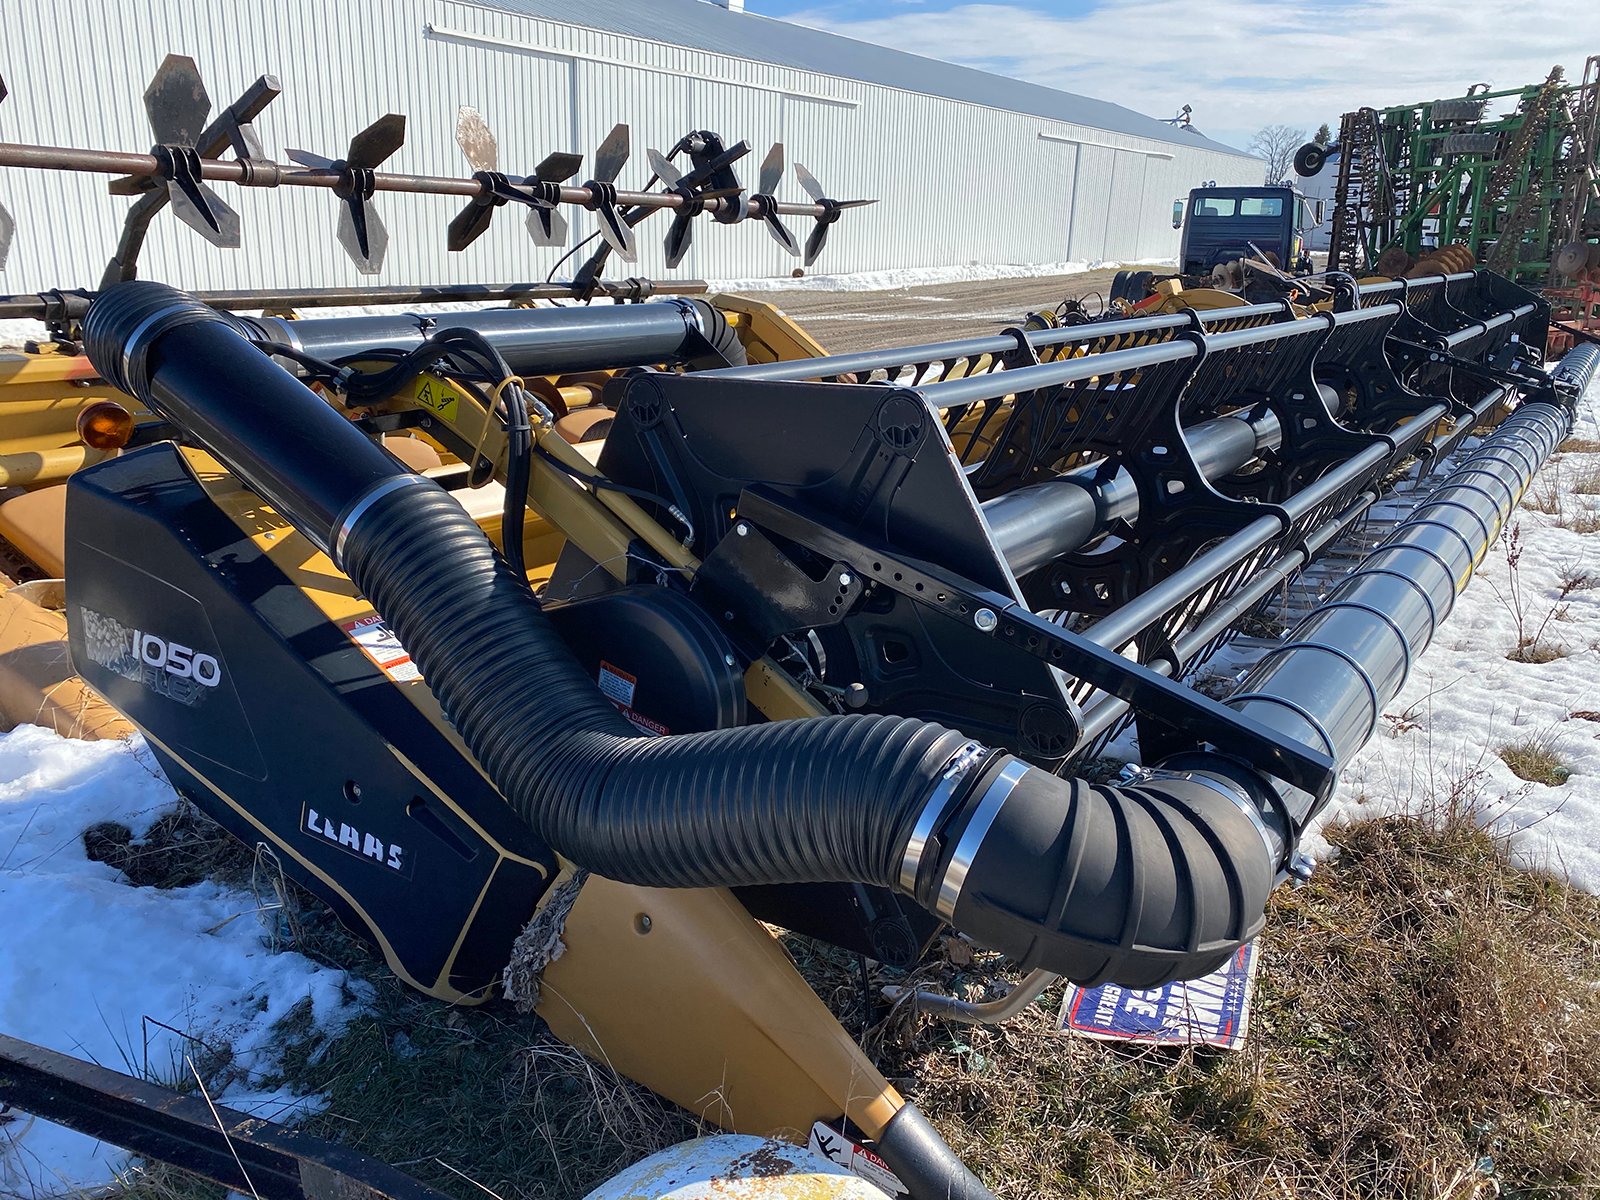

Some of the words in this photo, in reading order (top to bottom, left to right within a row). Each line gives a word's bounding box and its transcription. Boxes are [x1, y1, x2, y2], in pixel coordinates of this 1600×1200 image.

[132, 629, 222, 687] 1050
[631, 712, 667, 735] DANGER
[307, 808, 403, 871] CLAAS
[1093, 984, 1122, 1027] GREAT!
[869, 1154, 890, 1170] DAN
